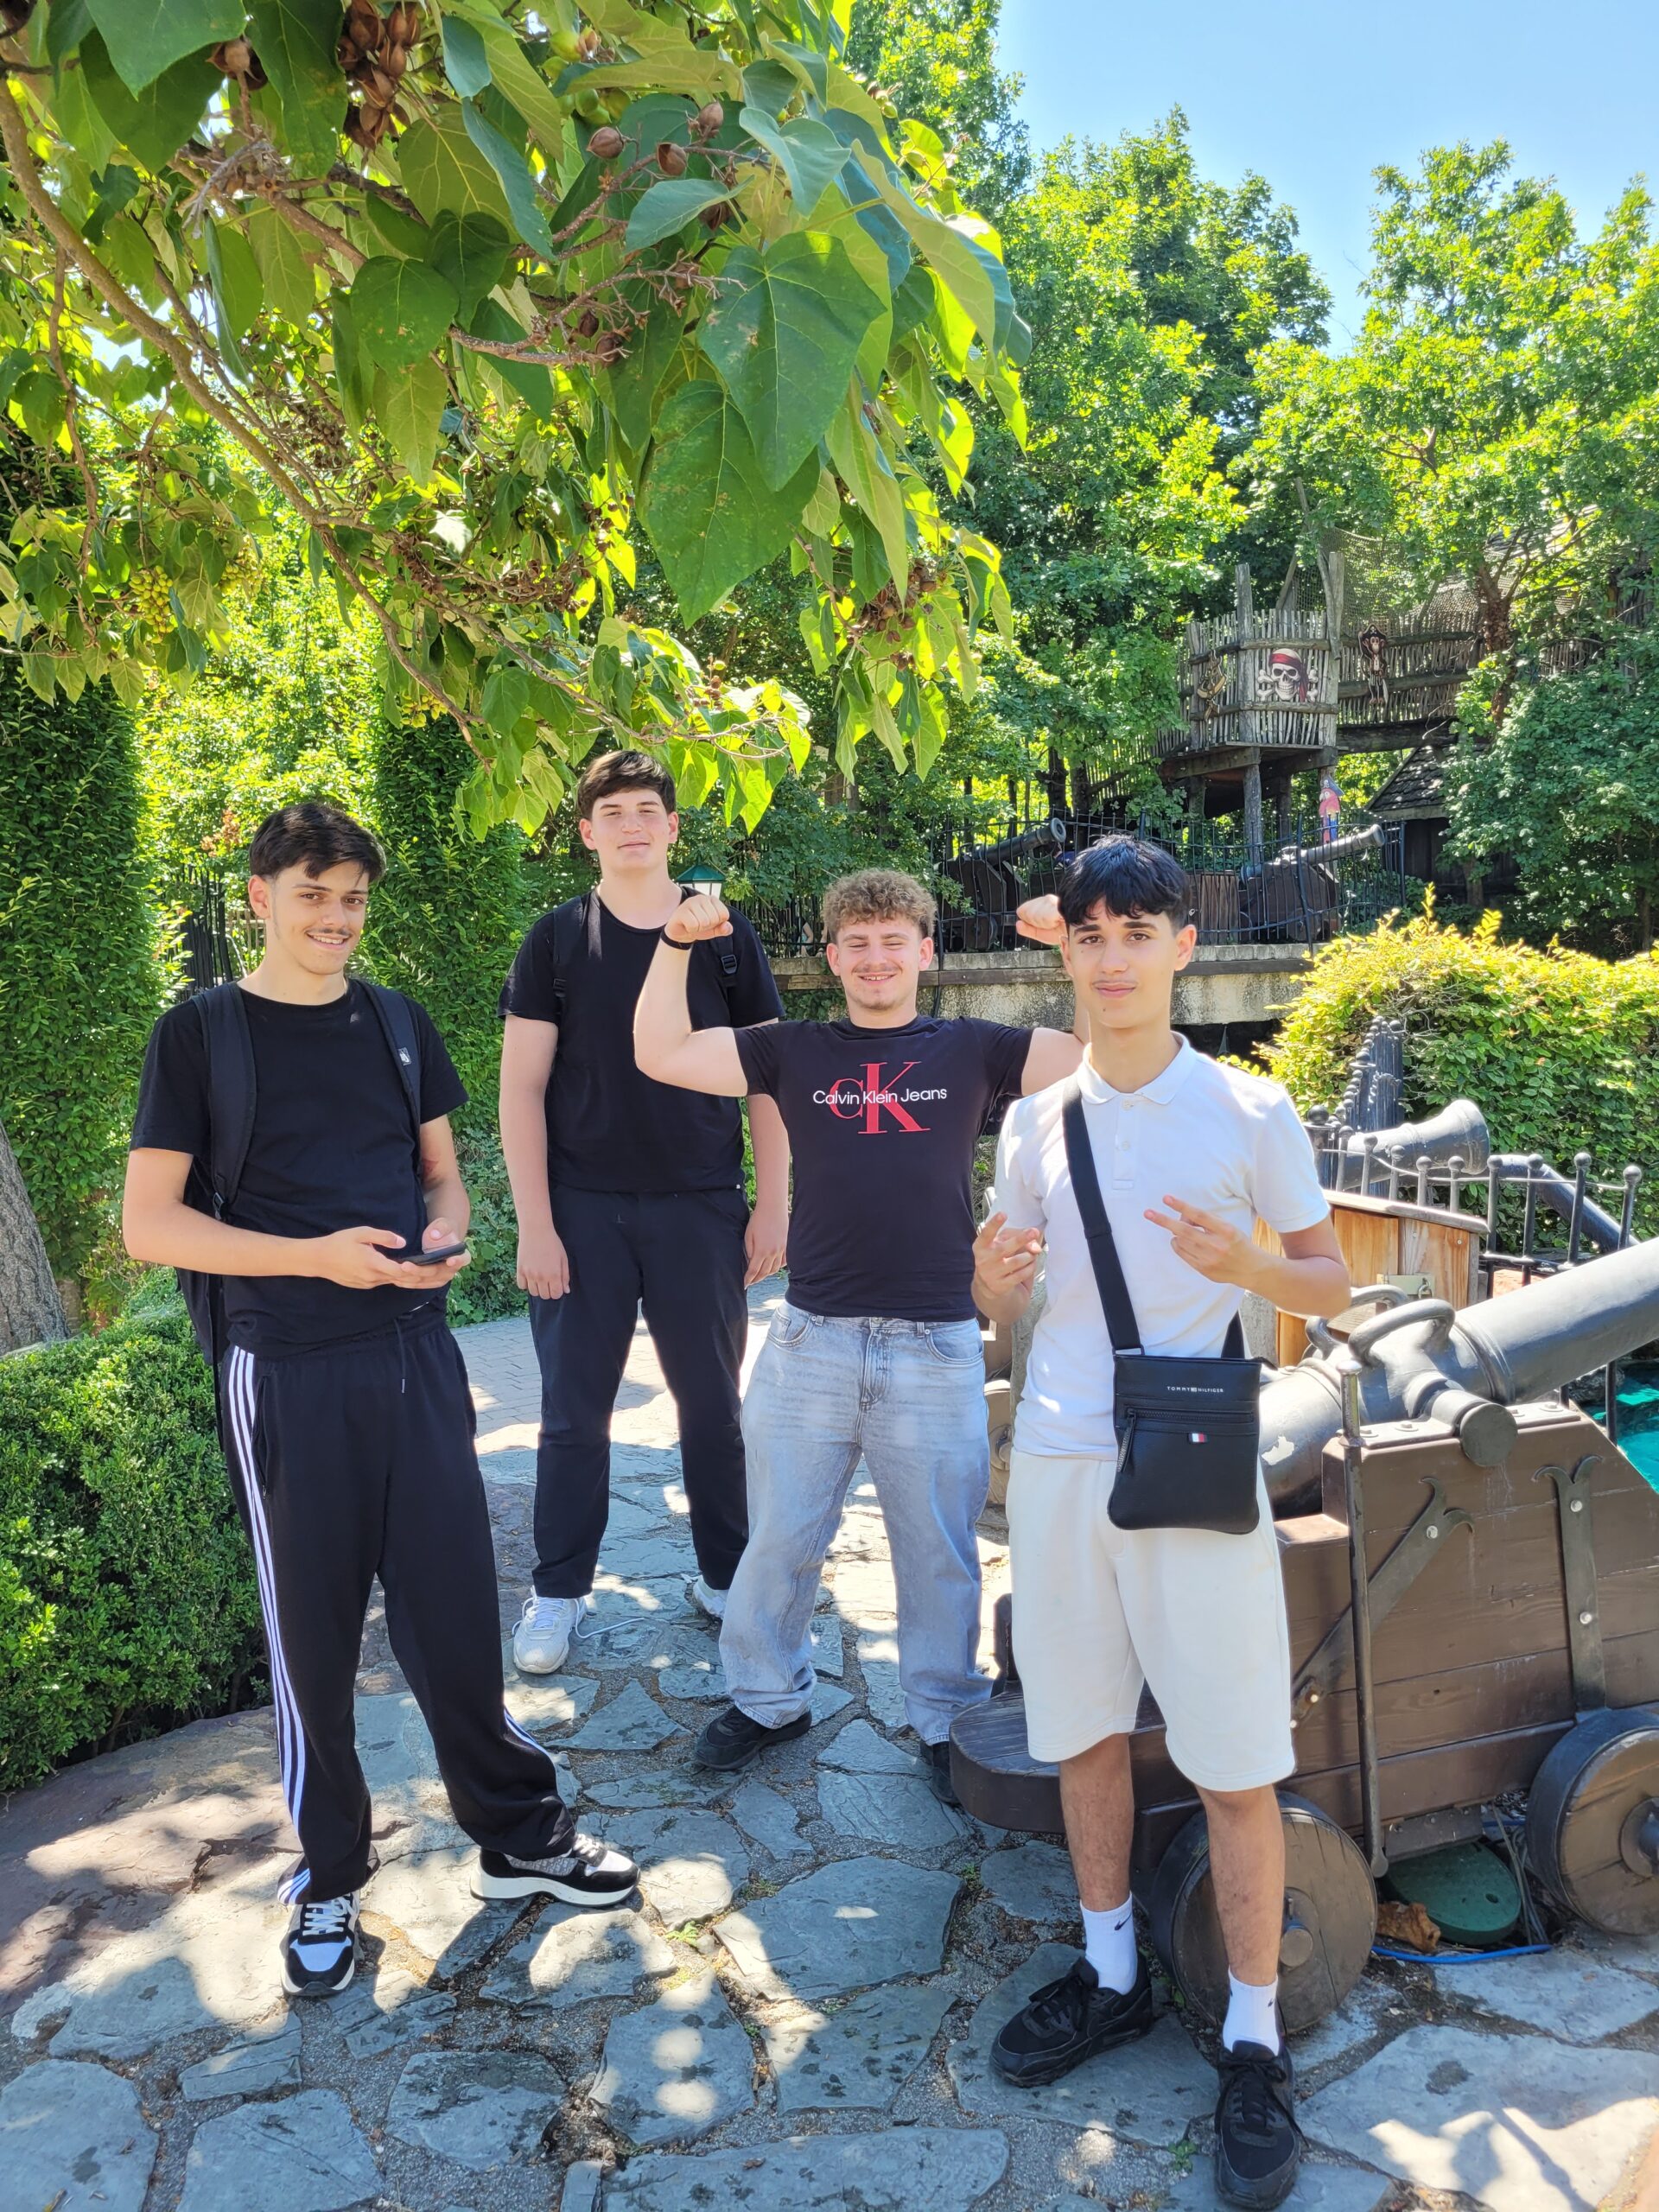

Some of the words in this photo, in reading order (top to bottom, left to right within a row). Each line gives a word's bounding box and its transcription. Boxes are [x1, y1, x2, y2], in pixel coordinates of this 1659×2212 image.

[812, 1090, 860, 1105] Calvin
[862, 1090, 898, 1105] Klein
[900, 1088, 947, 1103] Jeans
